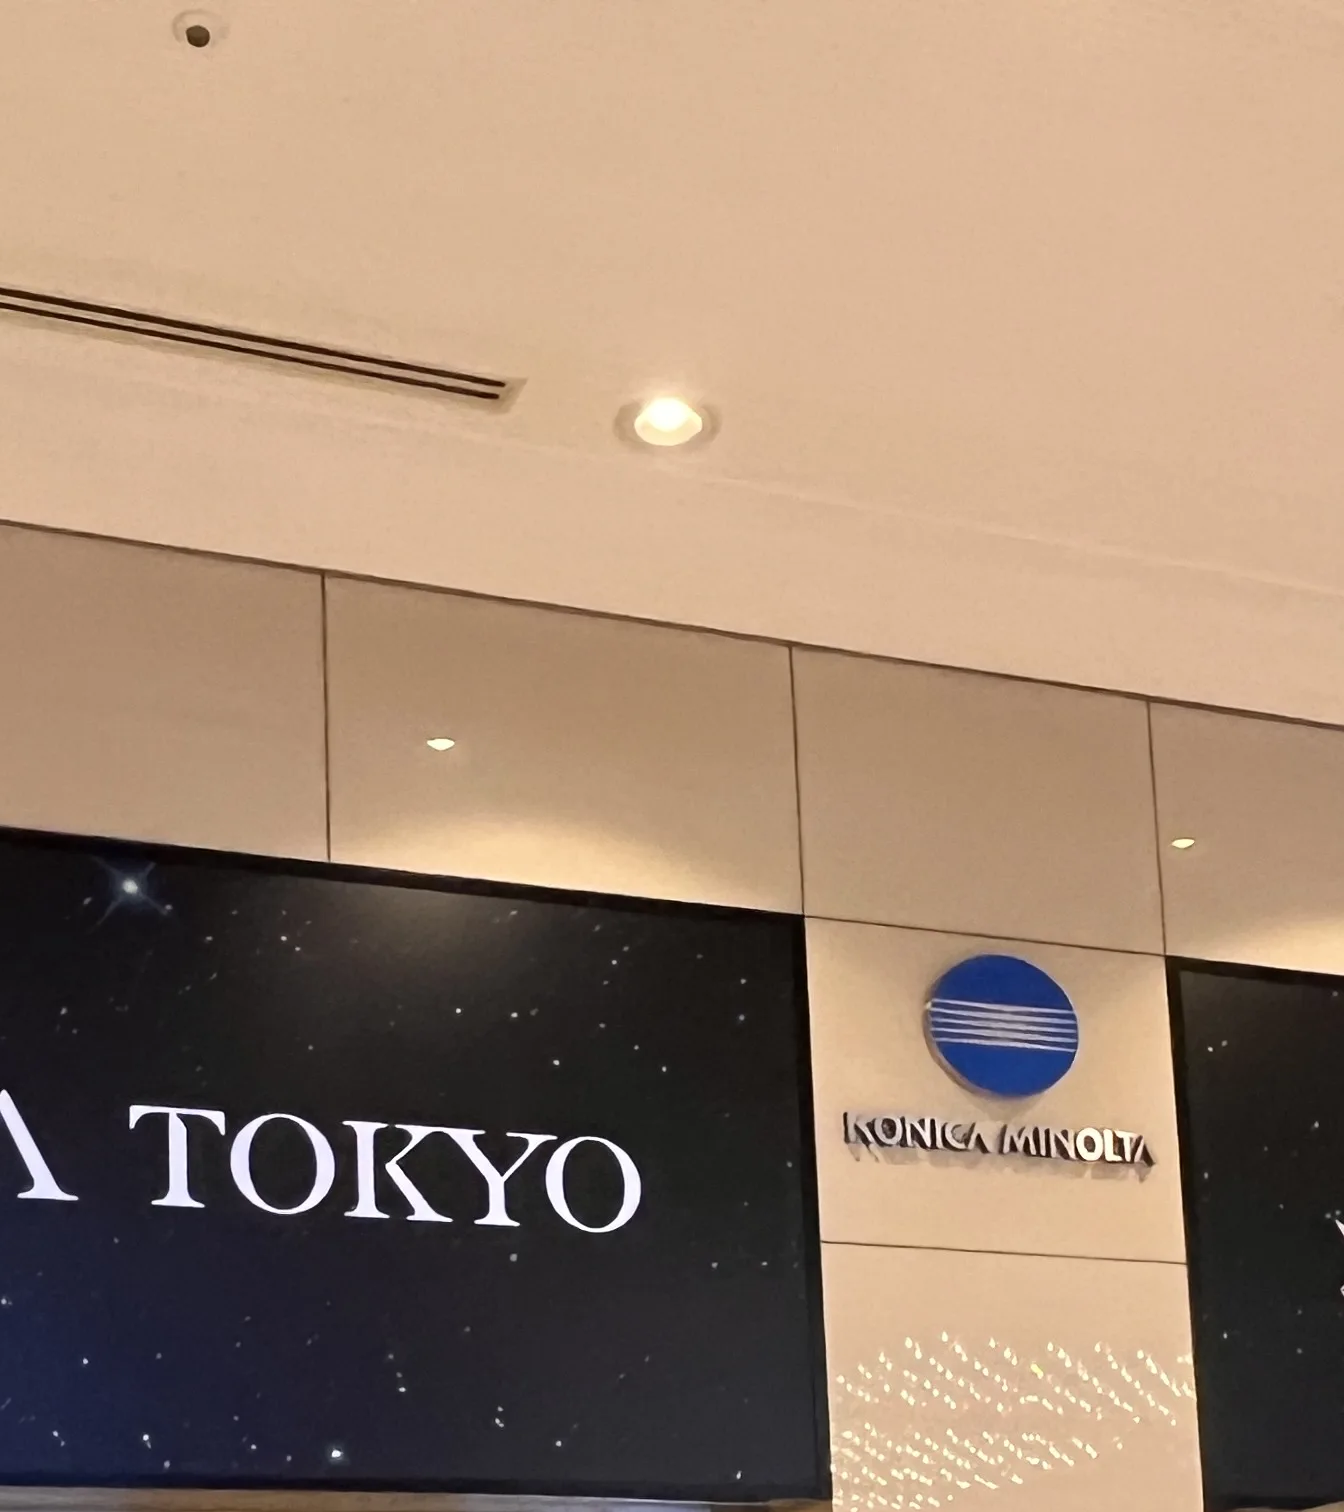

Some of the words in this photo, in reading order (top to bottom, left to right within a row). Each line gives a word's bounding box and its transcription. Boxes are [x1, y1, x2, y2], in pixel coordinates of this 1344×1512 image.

[129, 1105, 641, 1233] TOKYO
[843, 1112, 990, 1154] KONICA
[999, 1122, 1156, 1168] MINOLTA
